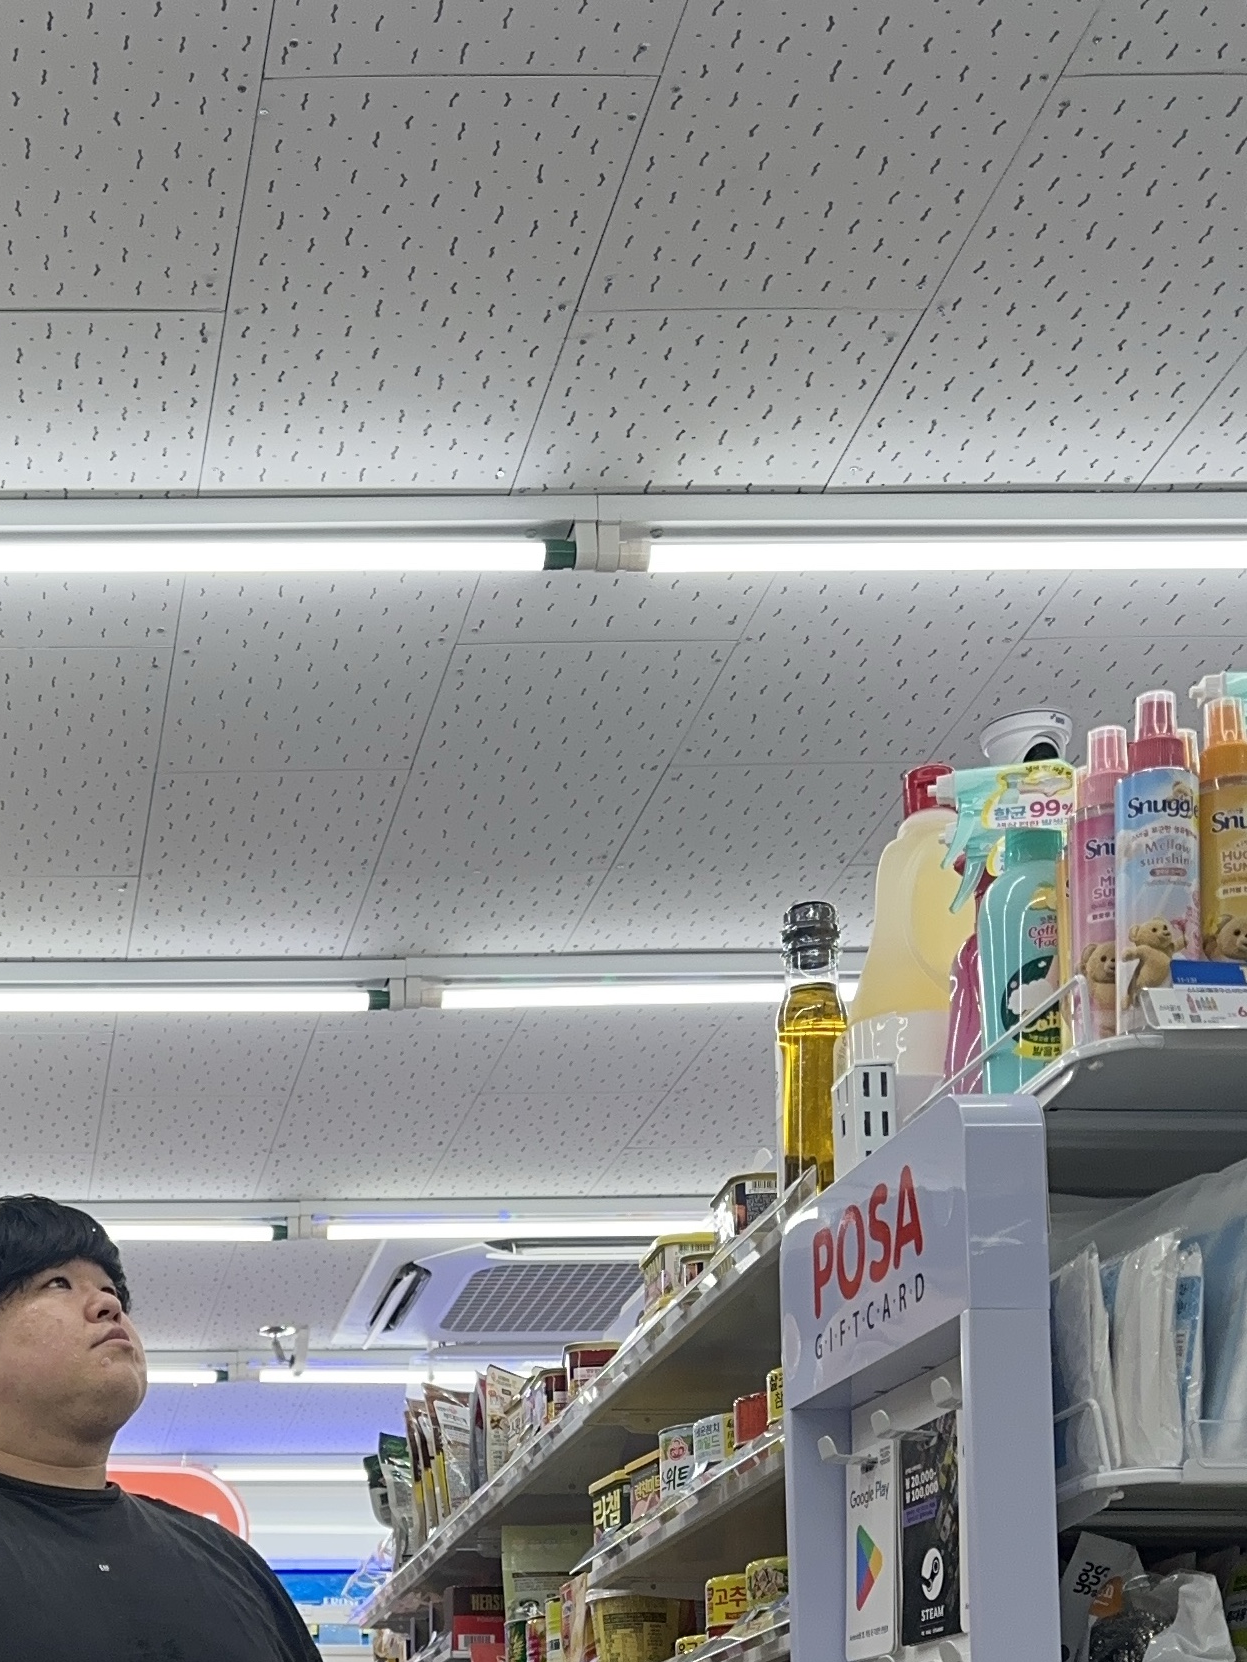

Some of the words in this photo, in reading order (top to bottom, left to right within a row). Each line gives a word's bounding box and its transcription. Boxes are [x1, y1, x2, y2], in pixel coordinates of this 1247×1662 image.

[1029, 800, 1074, 819] 99%
[1126, 795, 1199, 819] Snuggle
[811, 1164, 924, 1320] POSA
[849, 1483, 875, 1510] Google
[874, 1480, 890, 1501] Play
[591, 1487, 622, 1528] 리챔
[715, 1585, 747, 1609] 고추
[920, 1604, 945, 1623] STEAM
